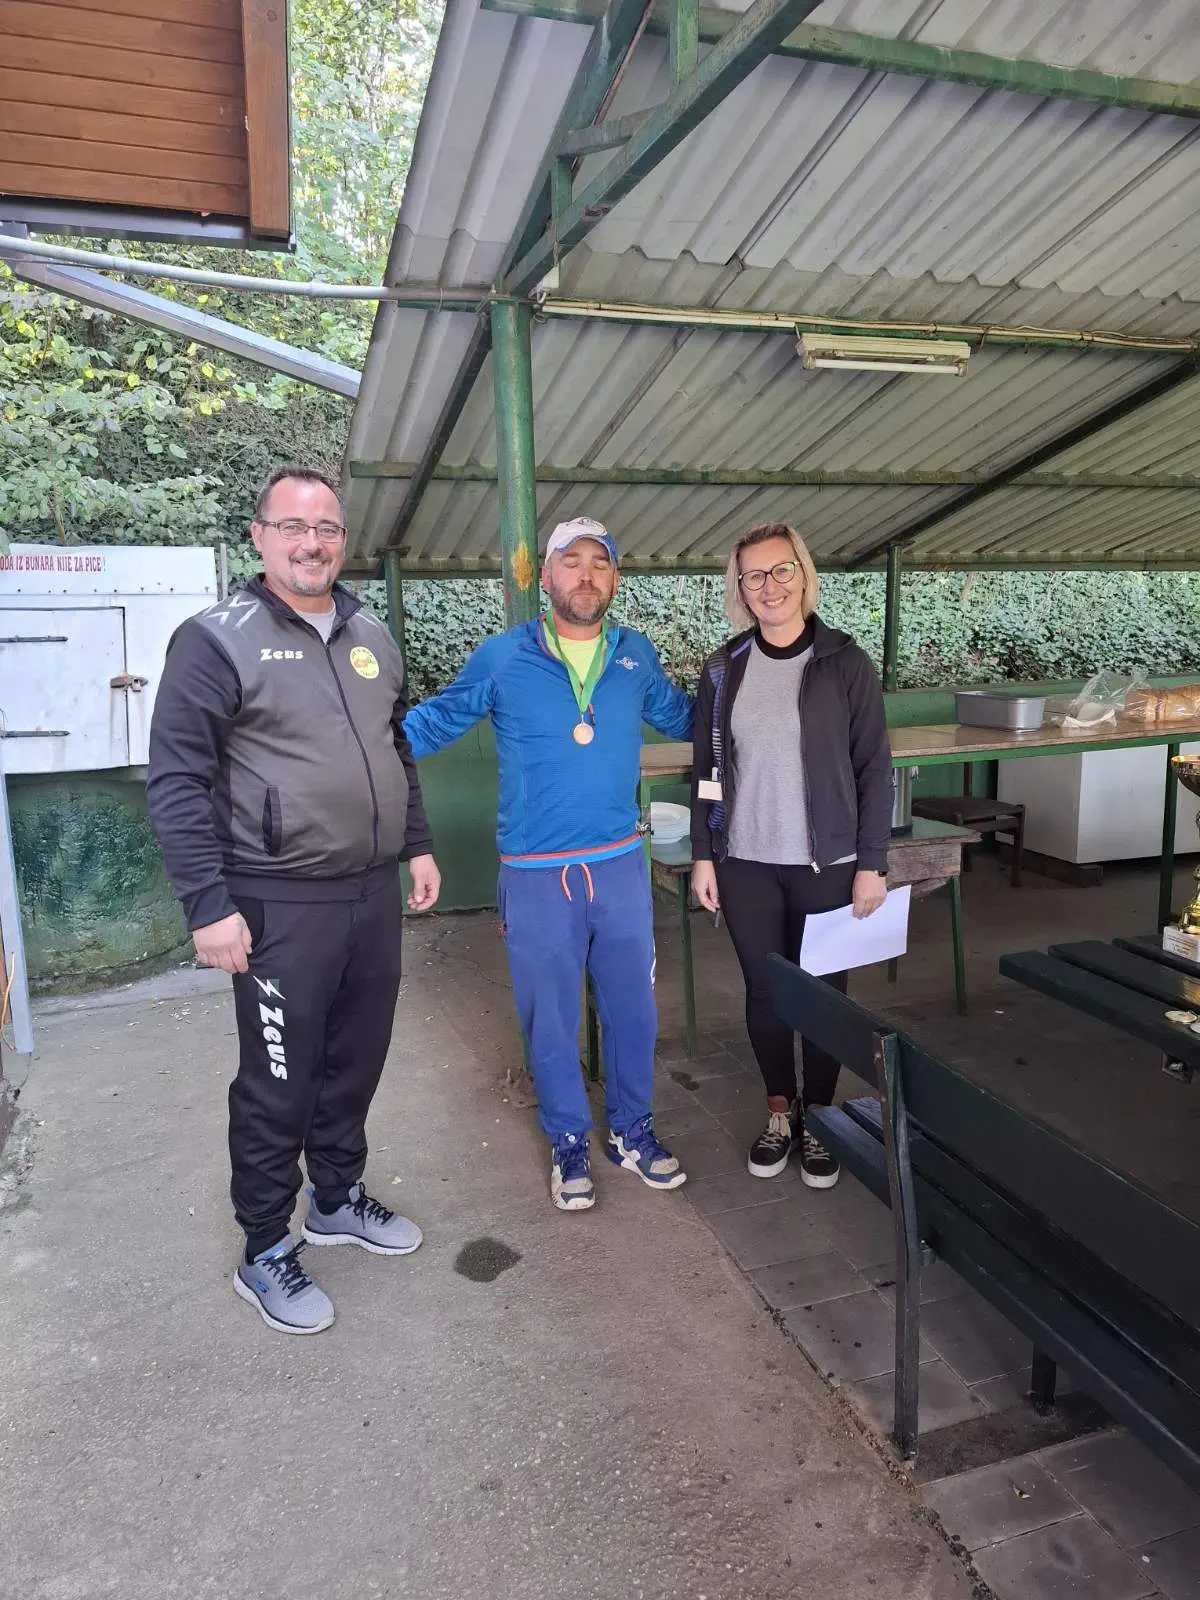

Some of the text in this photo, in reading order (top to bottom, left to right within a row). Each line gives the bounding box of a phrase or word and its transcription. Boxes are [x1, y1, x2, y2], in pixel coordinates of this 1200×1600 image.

[16, 555, 23, 571] IZ
[25, 555, 54, 571] BUNARA
[74, 556, 83, 572] ZA
[260, 648, 304, 661] Zeus
[259, 1002, 288, 1081] Zeus
